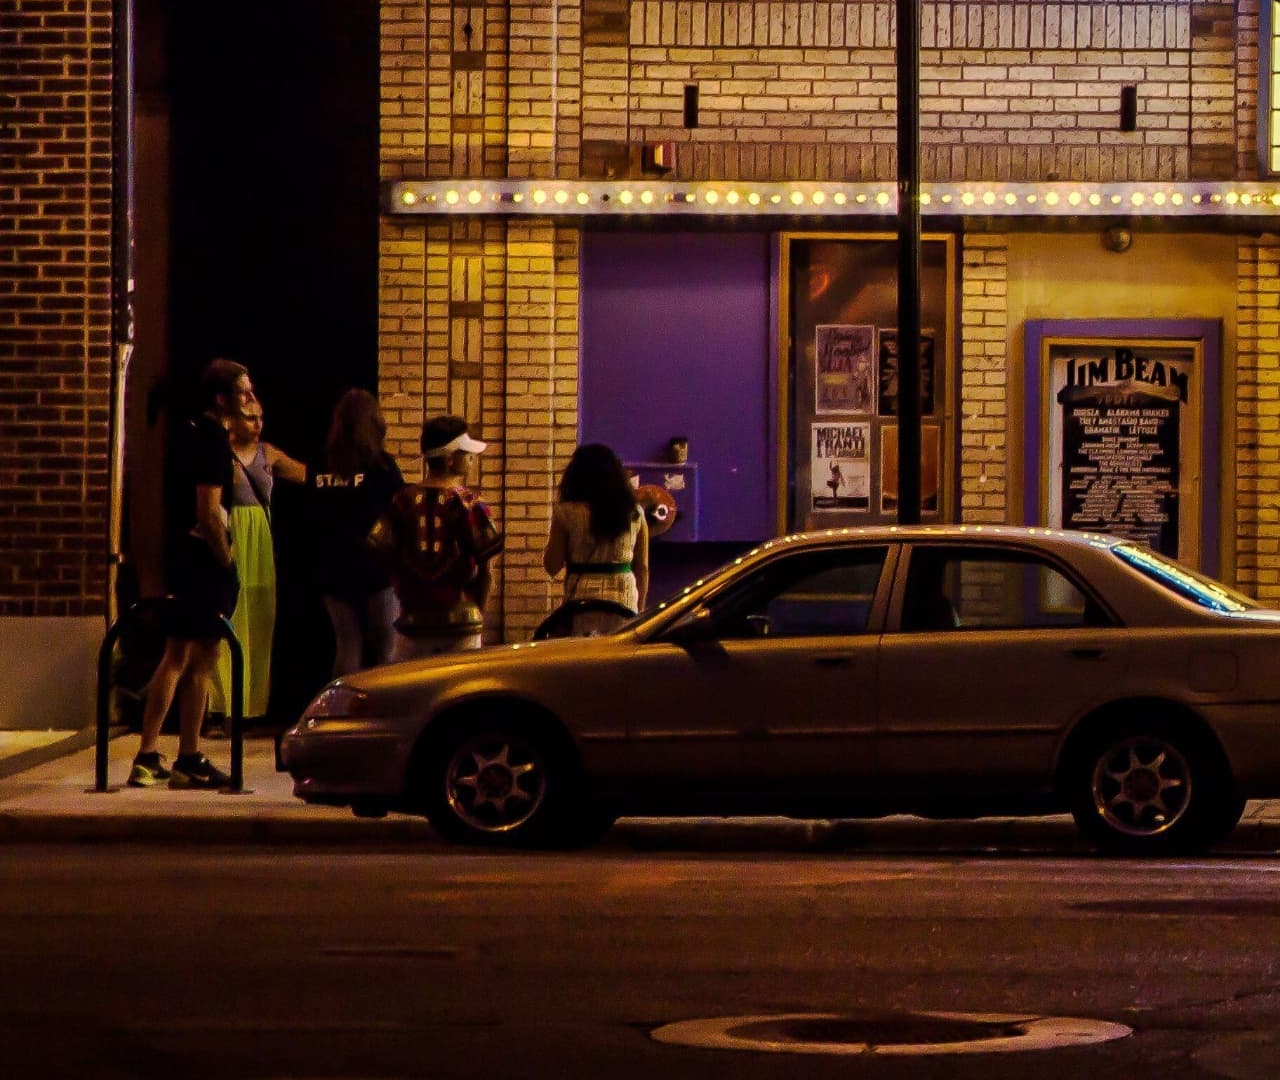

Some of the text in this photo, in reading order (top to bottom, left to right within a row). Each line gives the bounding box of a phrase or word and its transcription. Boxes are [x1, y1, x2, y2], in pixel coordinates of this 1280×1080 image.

[1067, 348, 1188, 405] JIM BEAM
[816, 427, 863, 439] MICHAEL
[315, 473, 365, 488] STAF
